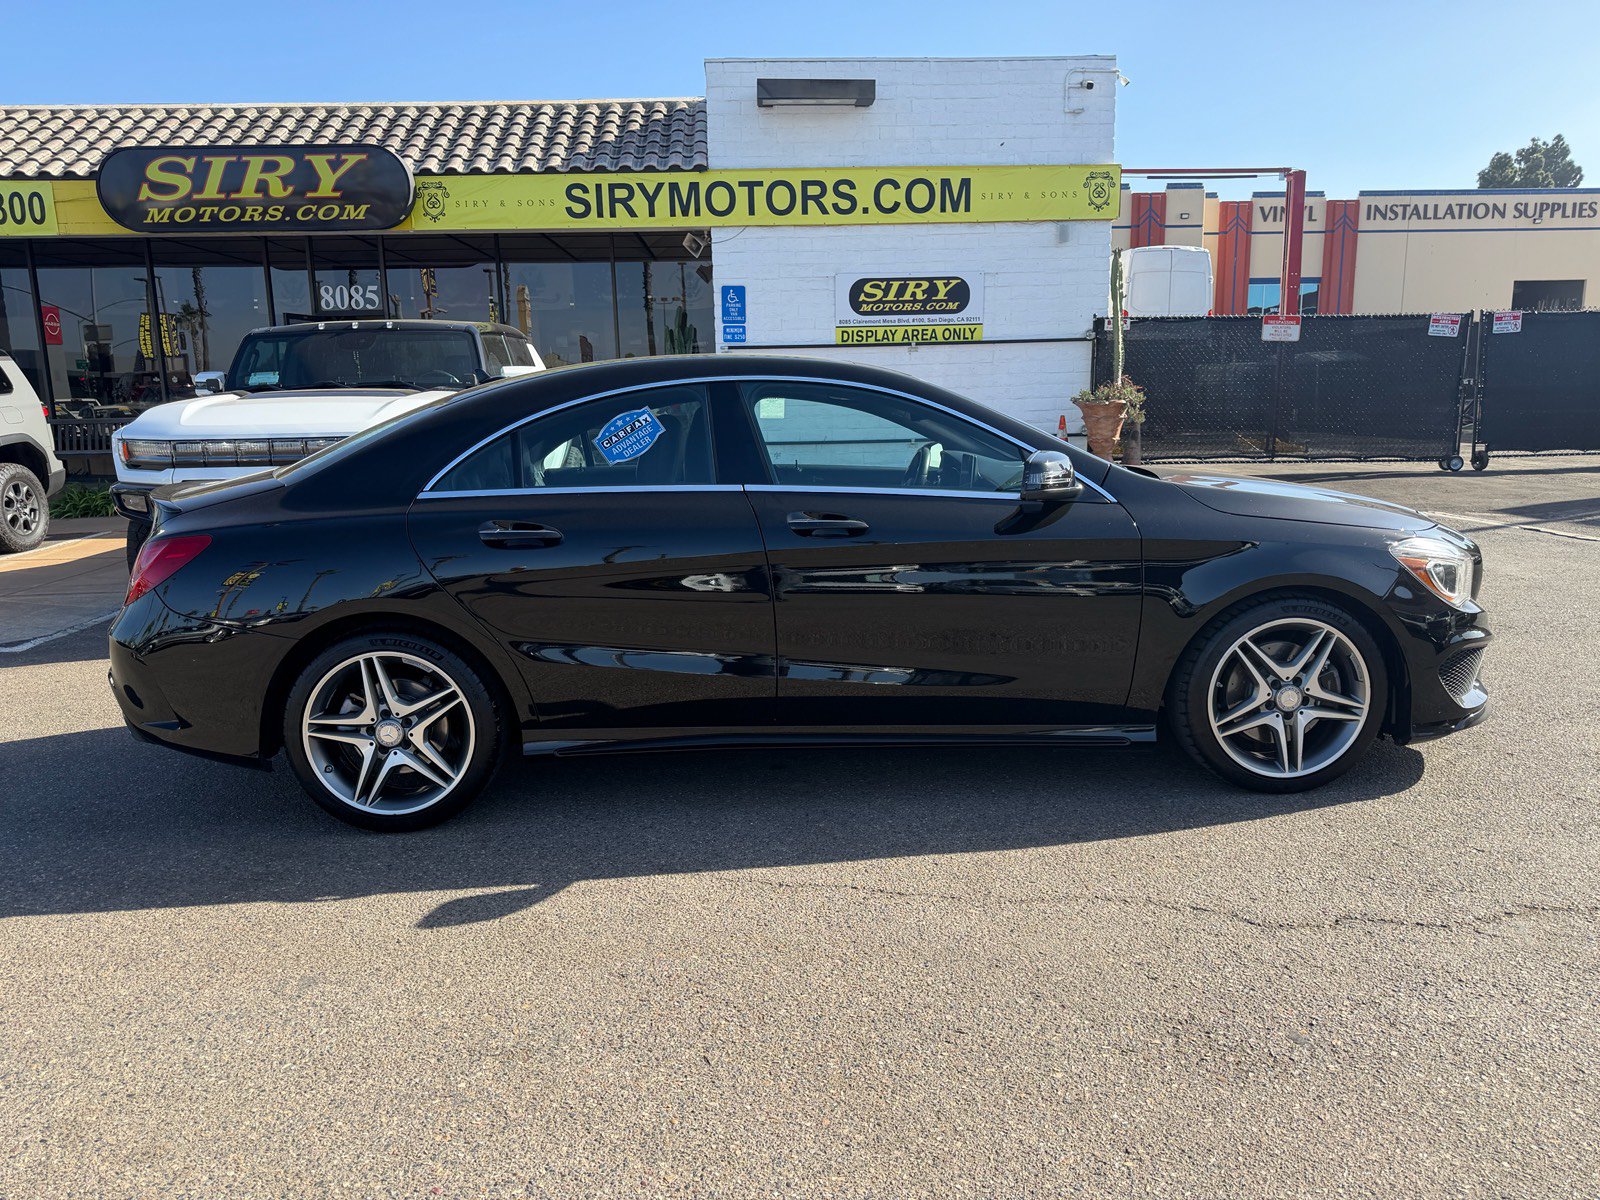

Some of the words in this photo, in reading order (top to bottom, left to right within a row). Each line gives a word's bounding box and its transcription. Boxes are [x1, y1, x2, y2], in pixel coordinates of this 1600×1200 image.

[137, 153, 369, 201] SIRY
[455, 200, 488, 208] SIRY
[500, 199, 506, 207] &
[517, 199, 555, 207] SONS
[565, 177, 972, 219] SIRYMOTORS.COM
[981, 192, 1014, 200] SIRY
[1024, 191, 1030, 199] &
[1040, 190, 1078, 199] SONS
[143, 204, 371, 223] MOTORS.COM
[1259, 205, 1317, 222] VIL
[1366, 203, 1507, 221] INSTALLATION
[1513, 202, 1598, 219] SUPPLIES
[320, 285, 379, 310] 8085
[858, 279, 961, 302] SIRY
[859, 301, 960, 312] MOTORS.COM
[841, 329, 898, 343] DISPLAY
[901, 328, 938, 341] AREA
[942, 327, 977, 340] ONLY
[602, 413, 652, 449] CARFAX
[611, 425, 654, 455] ADVANTAGE
[622, 436, 652, 457] DEALER
